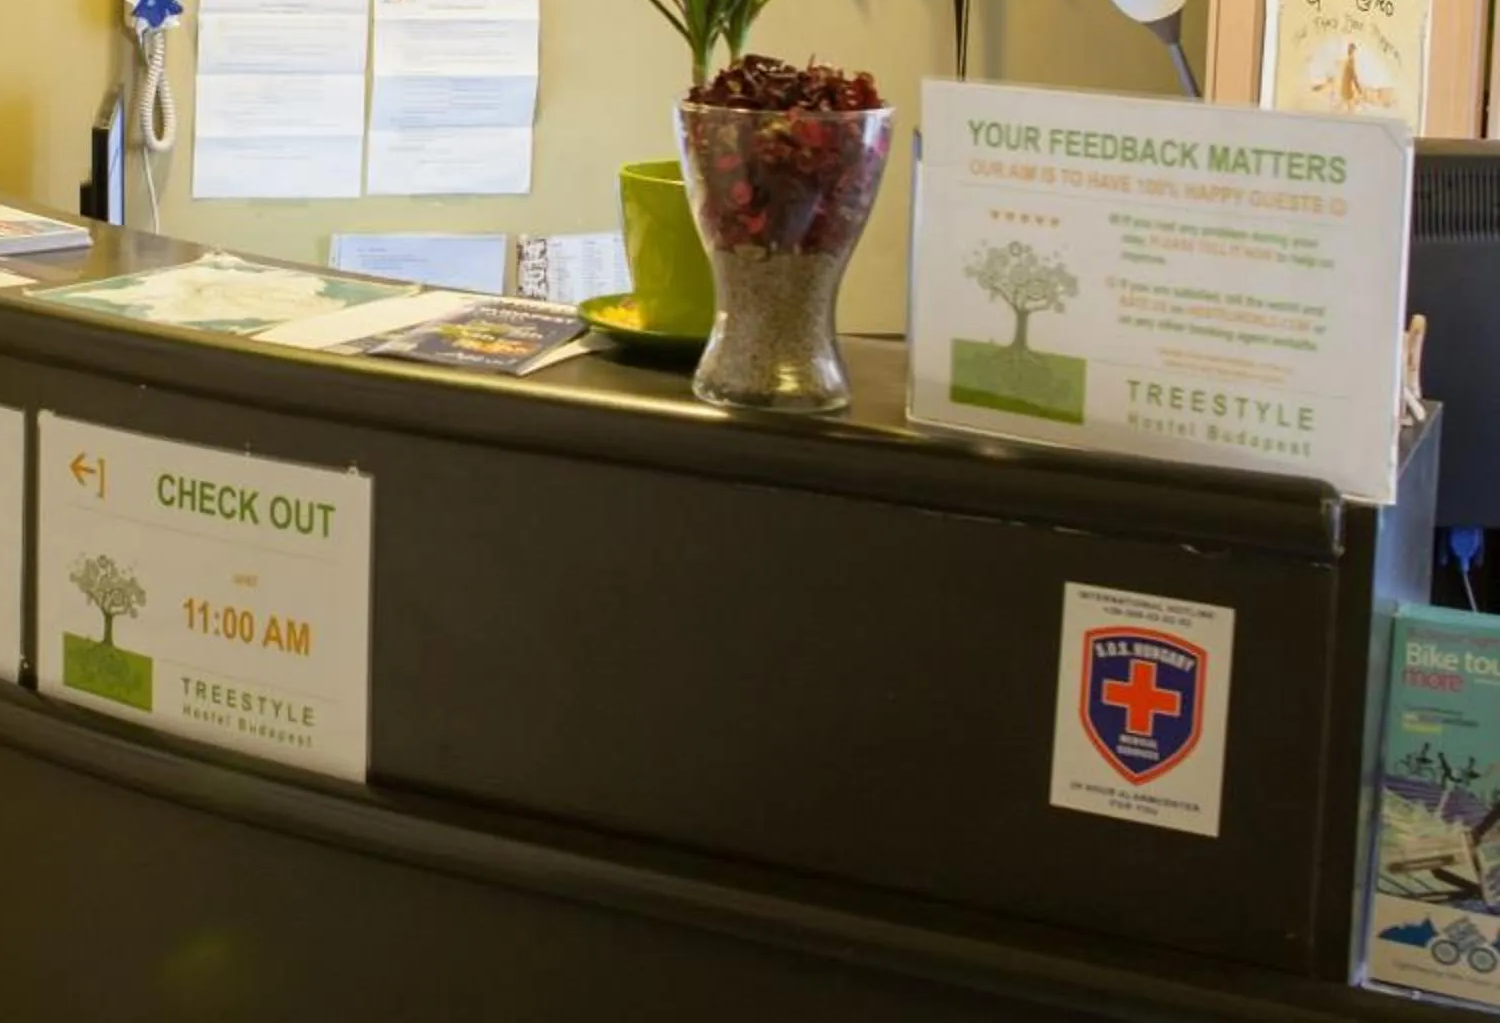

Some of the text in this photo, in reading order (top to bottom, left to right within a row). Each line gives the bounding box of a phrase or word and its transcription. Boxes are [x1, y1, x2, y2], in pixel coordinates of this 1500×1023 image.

[968, 119, 1347, 184] YOUR FEEDBACK MATTERS
[969, 159, 1003, 177] OUR
[1060, 168, 1083, 187] TO
[1087, 171, 1131, 193] HAVE
[1184, 182, 1244, 206] HAPPY
[1126, 379, 1316, 432] TREESTYLE
[1127, 411, 1312, 459] Hostel Budapest
[157, 474, 337, 538] CHECK OUT
[184, 598, 311, 656] 11:00 AM
[1133, 642, 1195, 673] HUNGARY
[1406, 643, 1459, 671] Bike
[181, 677, 316, 727] TREESTYLE
[182, 704, 313, 748] Hostel Budapest
